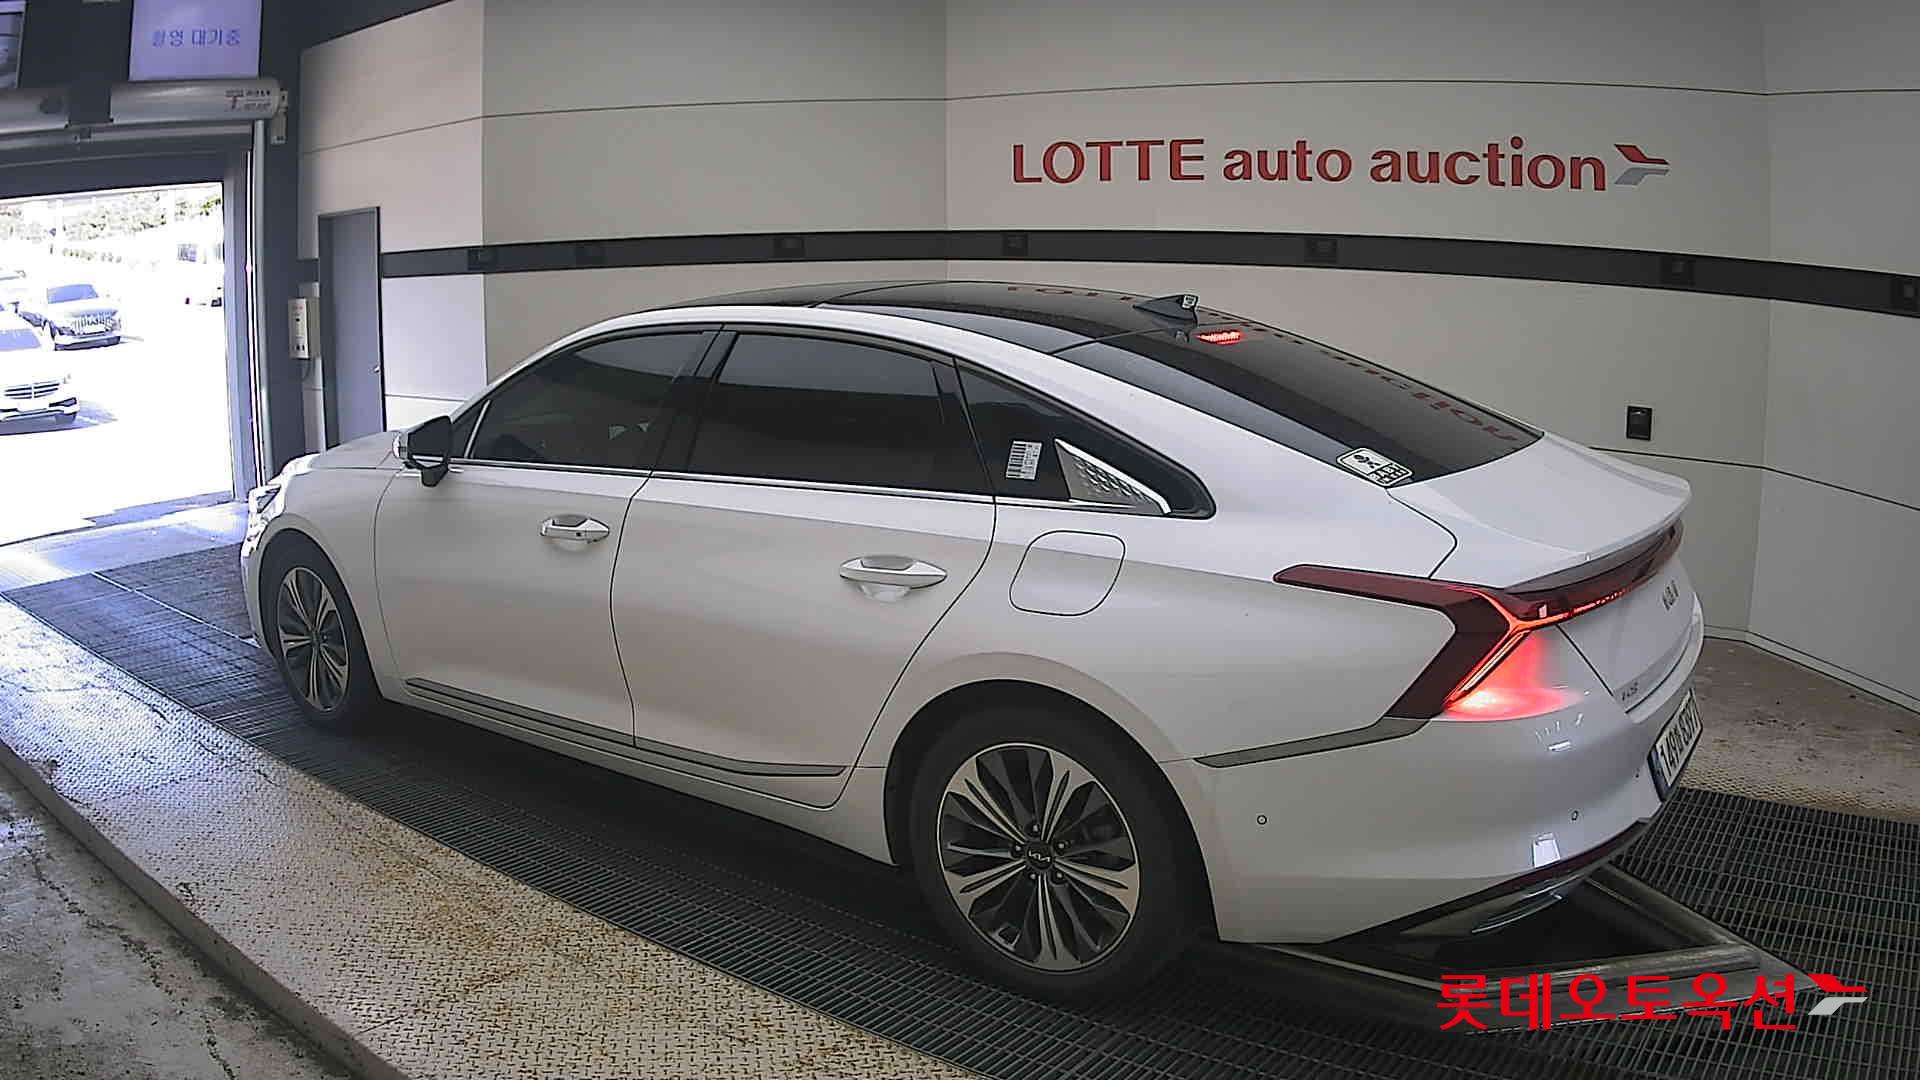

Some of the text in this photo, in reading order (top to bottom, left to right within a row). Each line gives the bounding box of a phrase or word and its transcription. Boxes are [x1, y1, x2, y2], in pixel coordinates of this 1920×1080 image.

[1012, 137, 1607, 192] LOTTE auto auction
